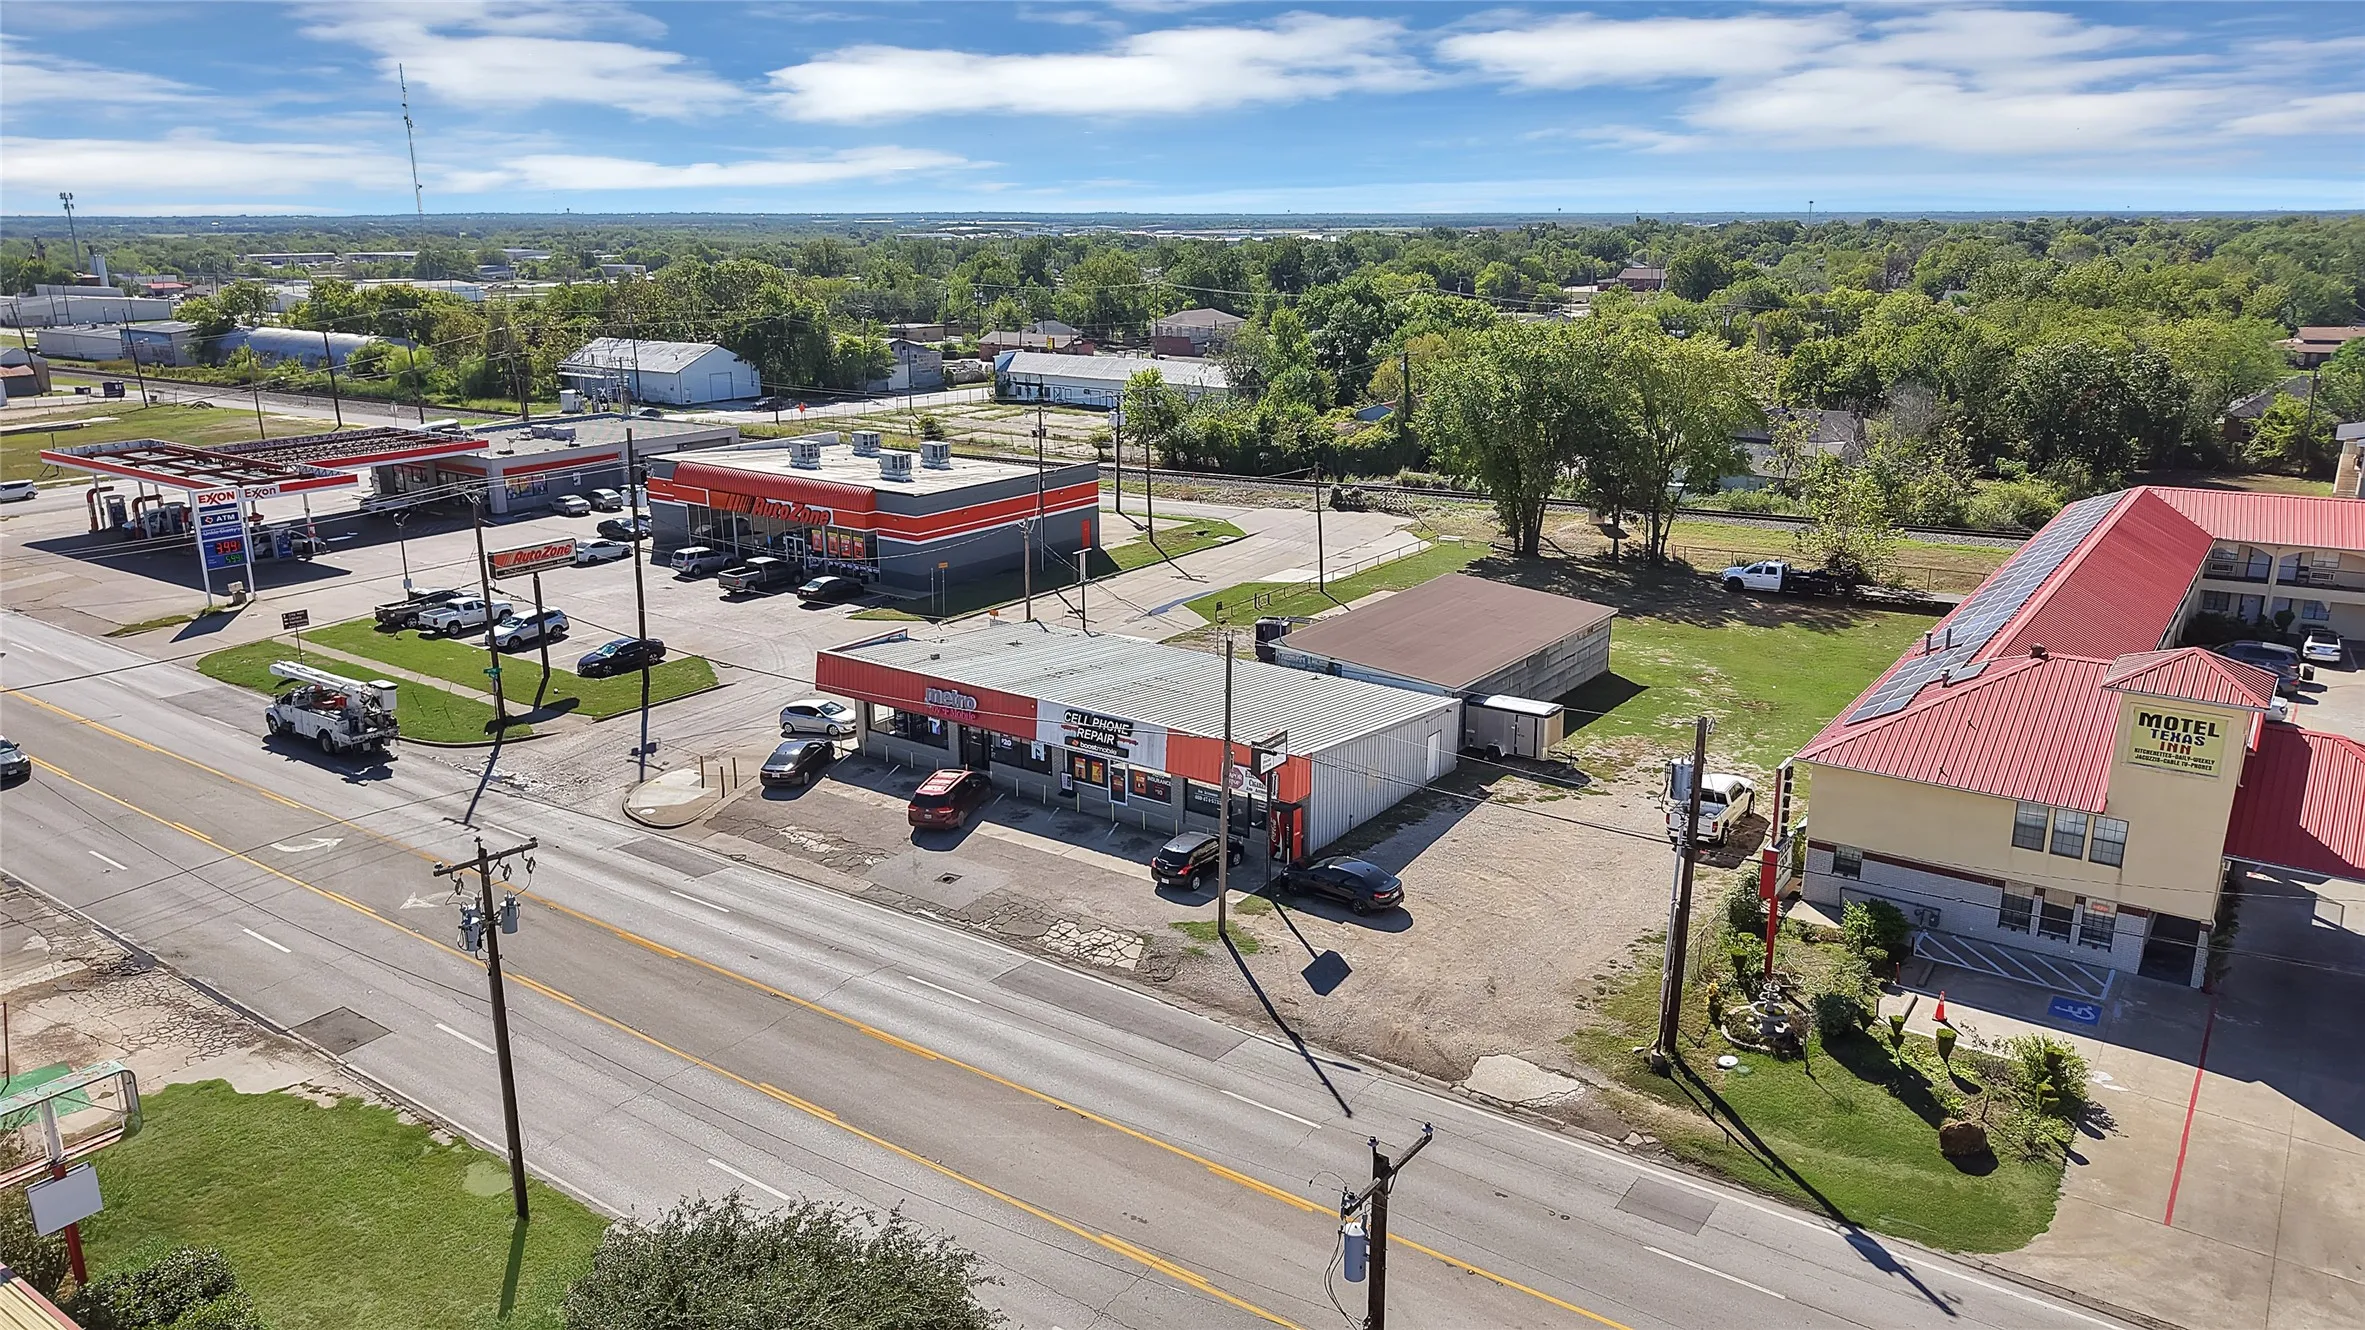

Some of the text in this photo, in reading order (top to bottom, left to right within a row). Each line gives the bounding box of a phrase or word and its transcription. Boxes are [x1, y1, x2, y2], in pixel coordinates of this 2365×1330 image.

[197, 491, 235, 505] EXXON
[244, 487, 276, 499] Exxon
[216, 514, 235, 522] ATM
[752, 497, 831, 526] AutoZone
[513, 544, 573, 564] AutoZone
[926, 688, 977, 710] metro
[1064, 711, 1130, 736] CELL PHONE
[2138, 712, 2220, 738] MOTEL
[1077, 728, 1115, 745] REPAIR
[2150, 728, 2206, 746] TEXAS
[2159, 741, 2192, 755] INN
